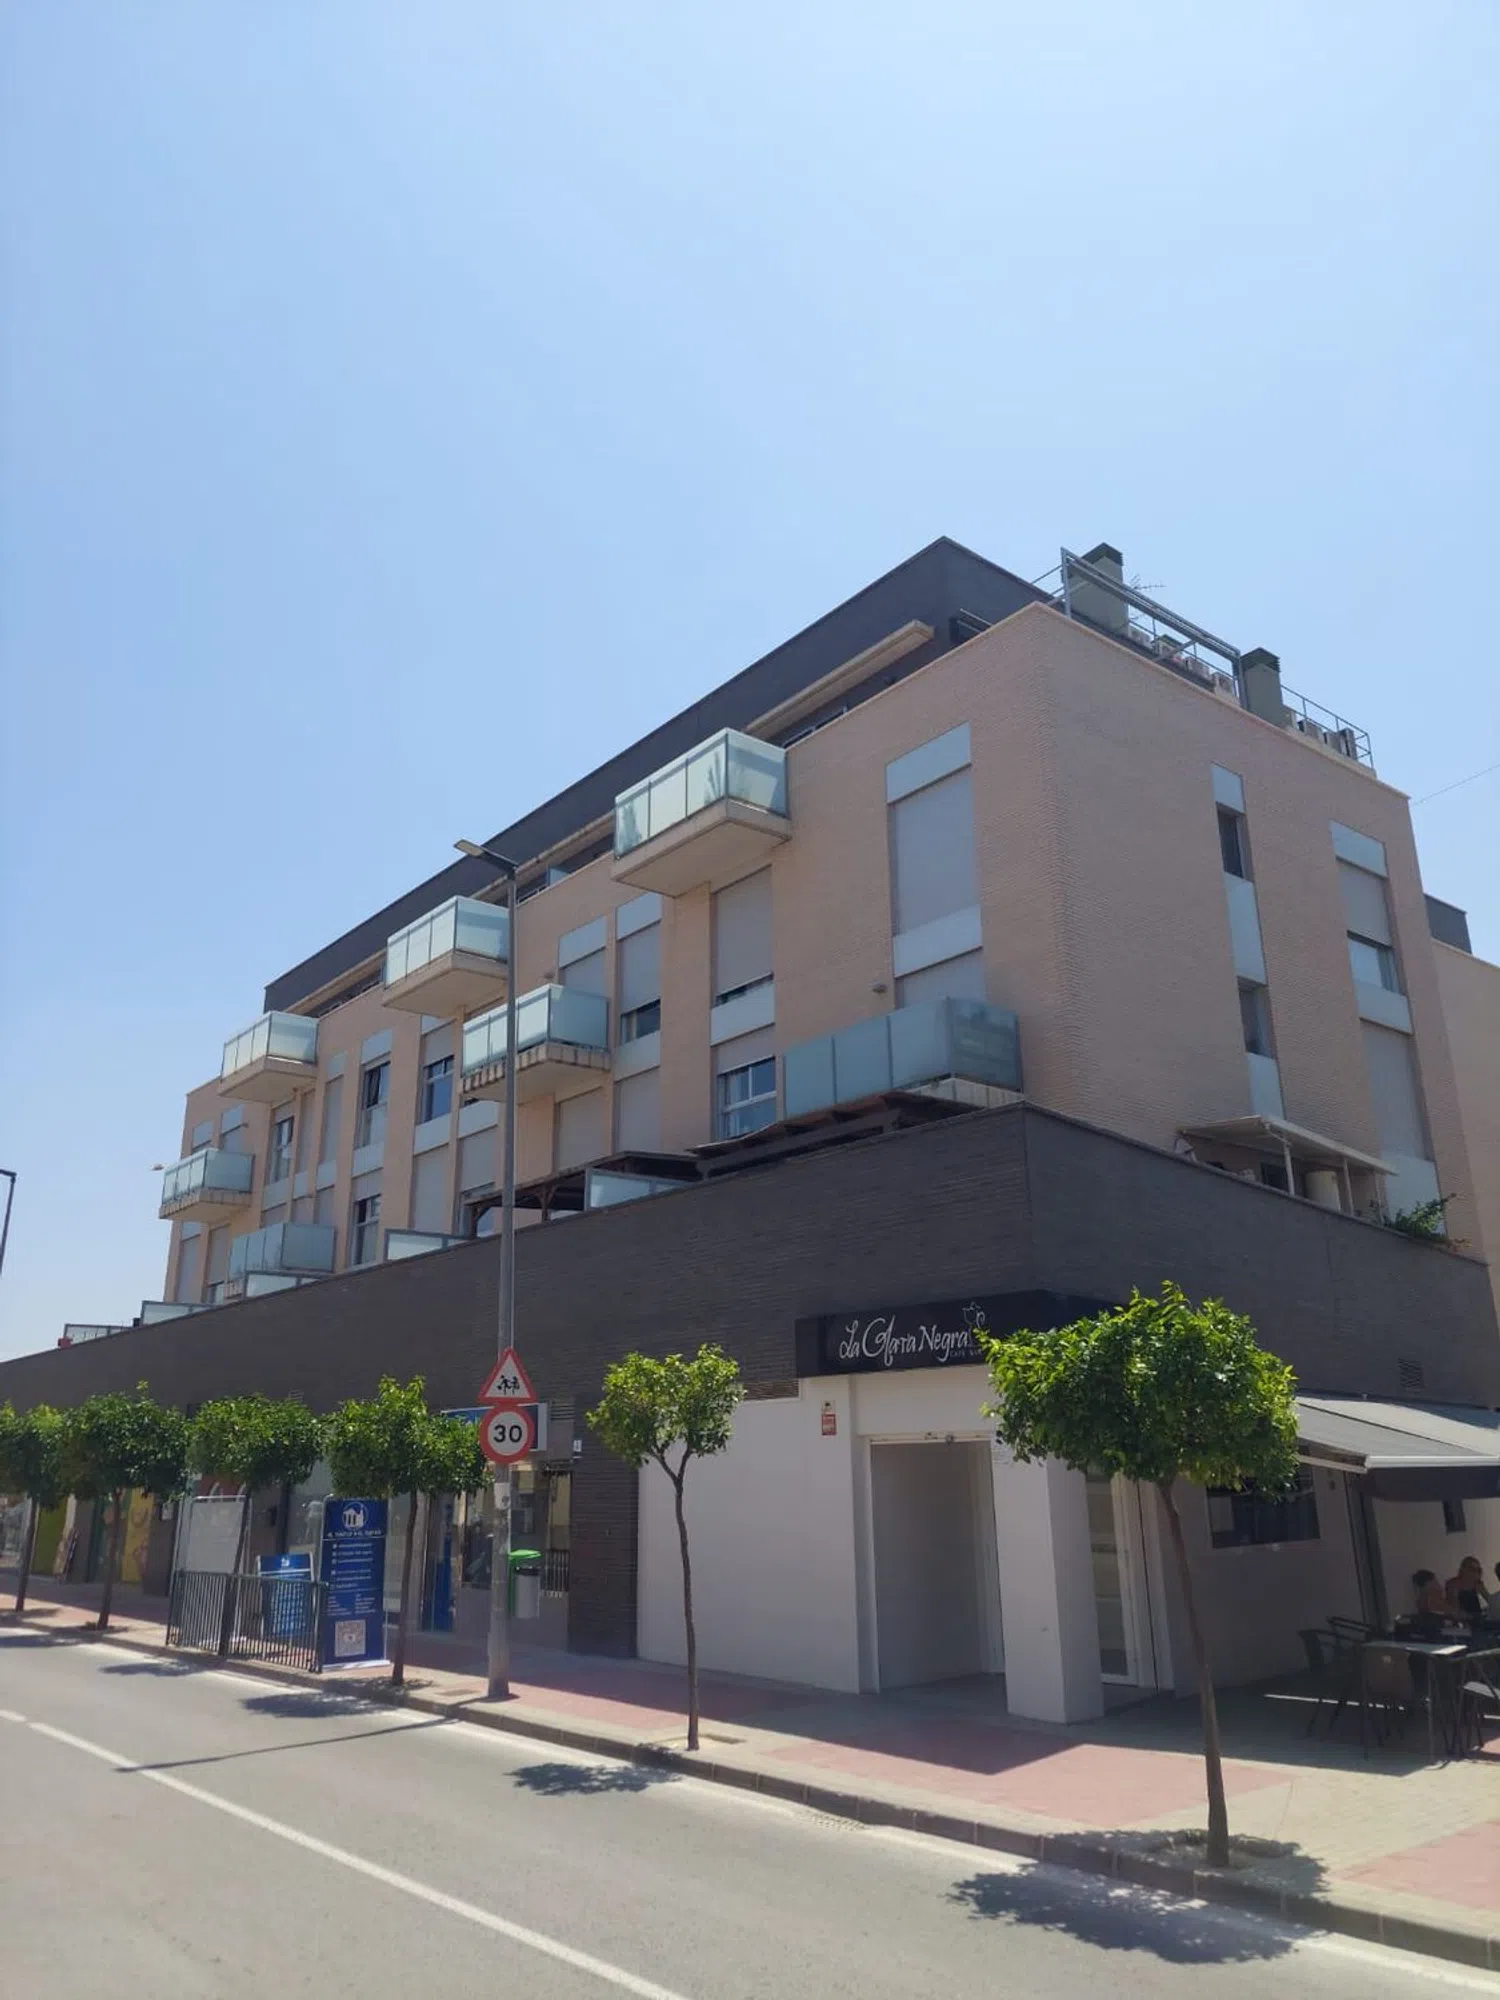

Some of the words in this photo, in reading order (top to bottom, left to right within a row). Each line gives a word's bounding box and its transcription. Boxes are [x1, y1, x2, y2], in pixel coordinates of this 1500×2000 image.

[839, 1319, 860, 1360] La
[918, 1324, 968, 1363] Negra
[493, 1424, 523, 1443] 30
